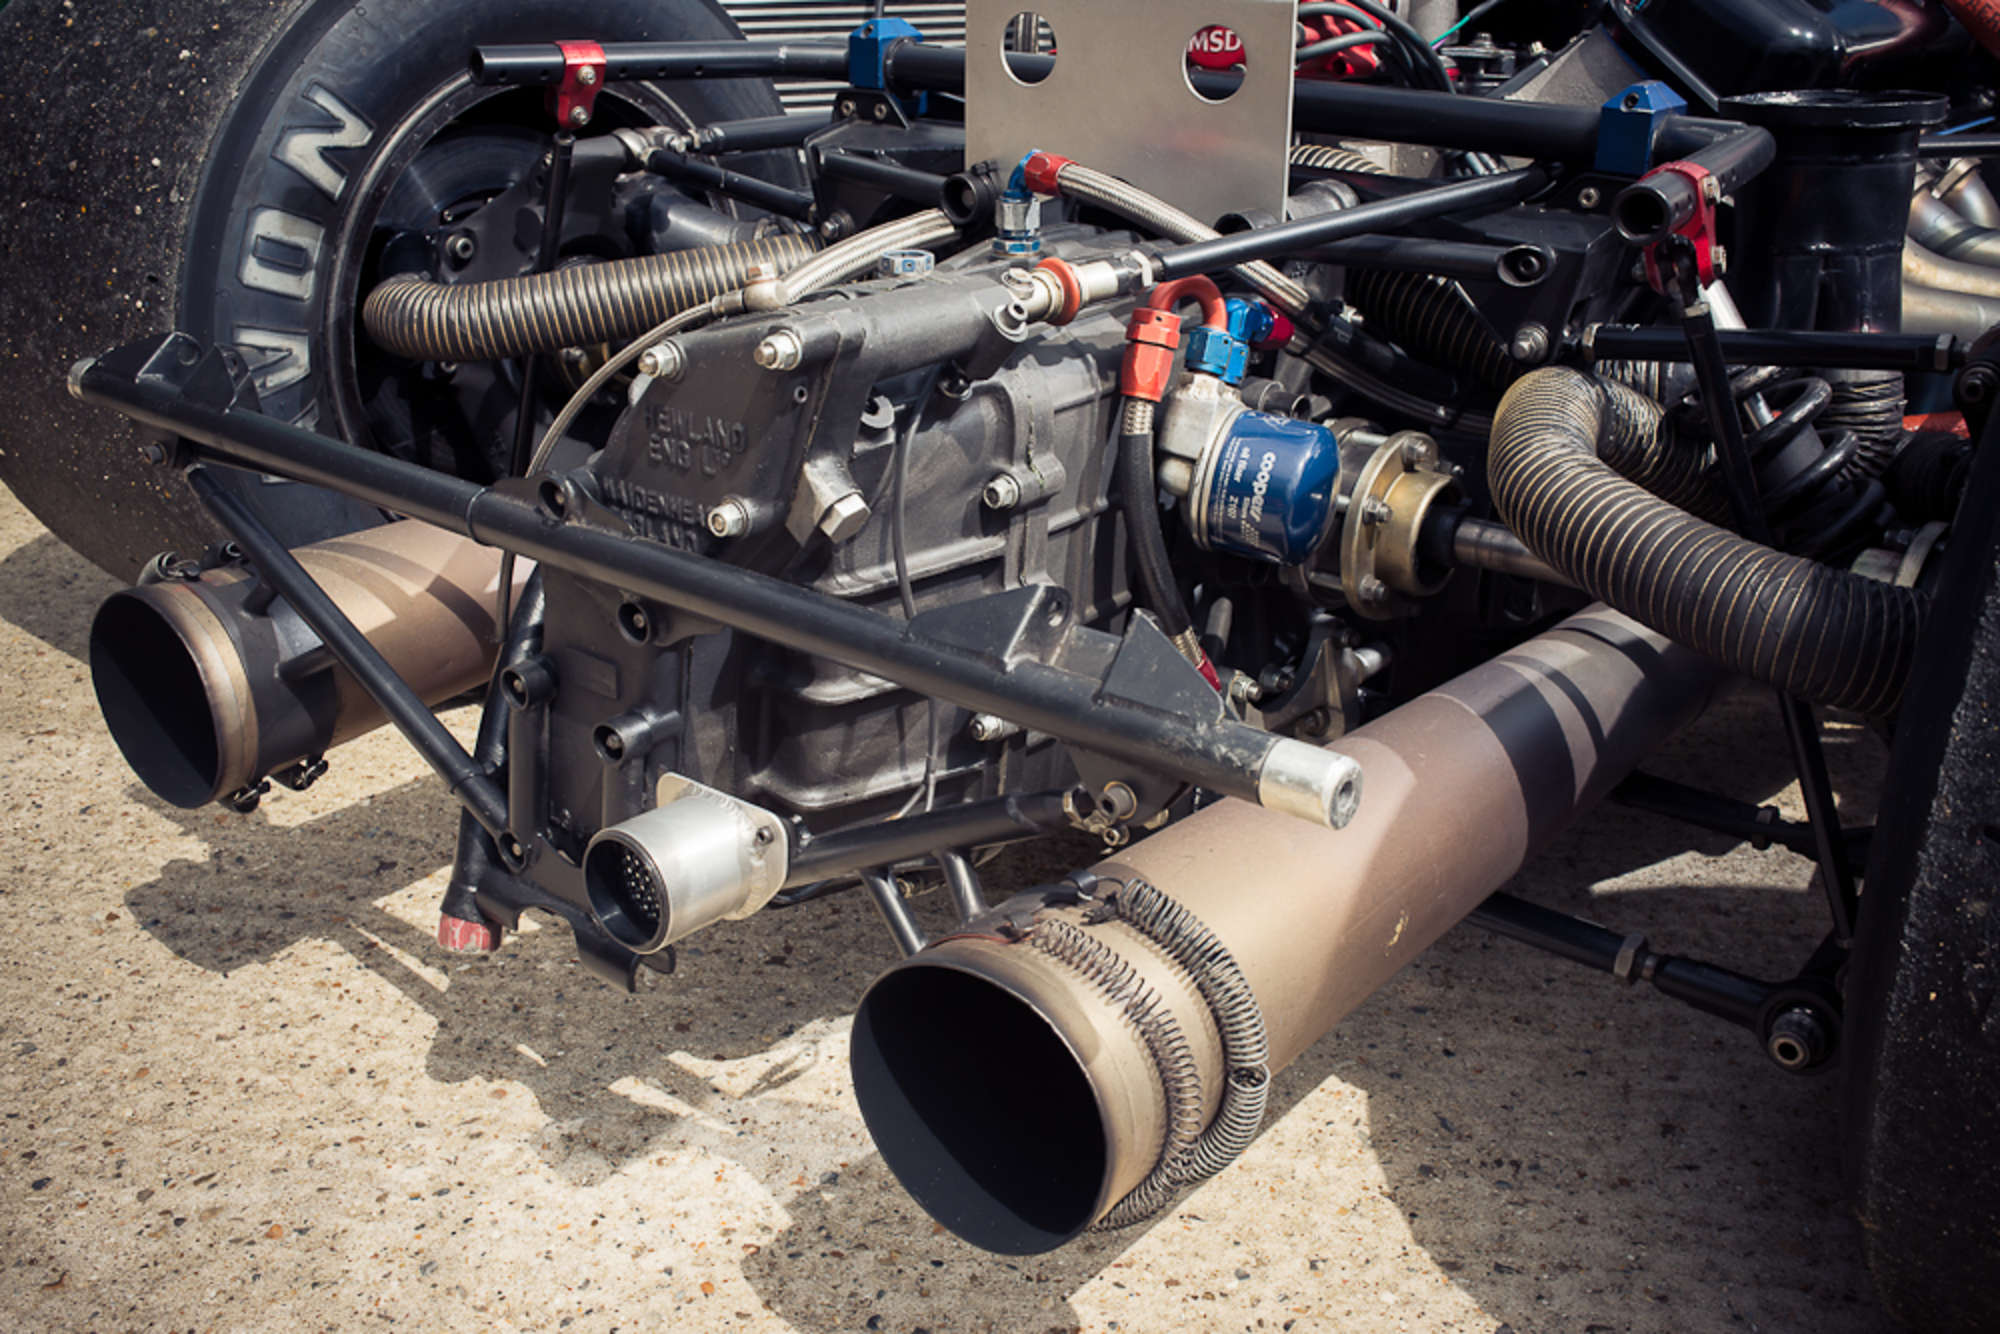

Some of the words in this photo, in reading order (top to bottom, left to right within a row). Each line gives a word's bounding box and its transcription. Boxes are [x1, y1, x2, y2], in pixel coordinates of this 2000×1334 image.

[1188, 29, 1242, 52] MSD
[233, 78, 376, 483] VON
[649, 432, 691, 470] ENG
[603, 475, 711, 527] MAIDENHEA
[1251, 452, 1276, 522] coopers
